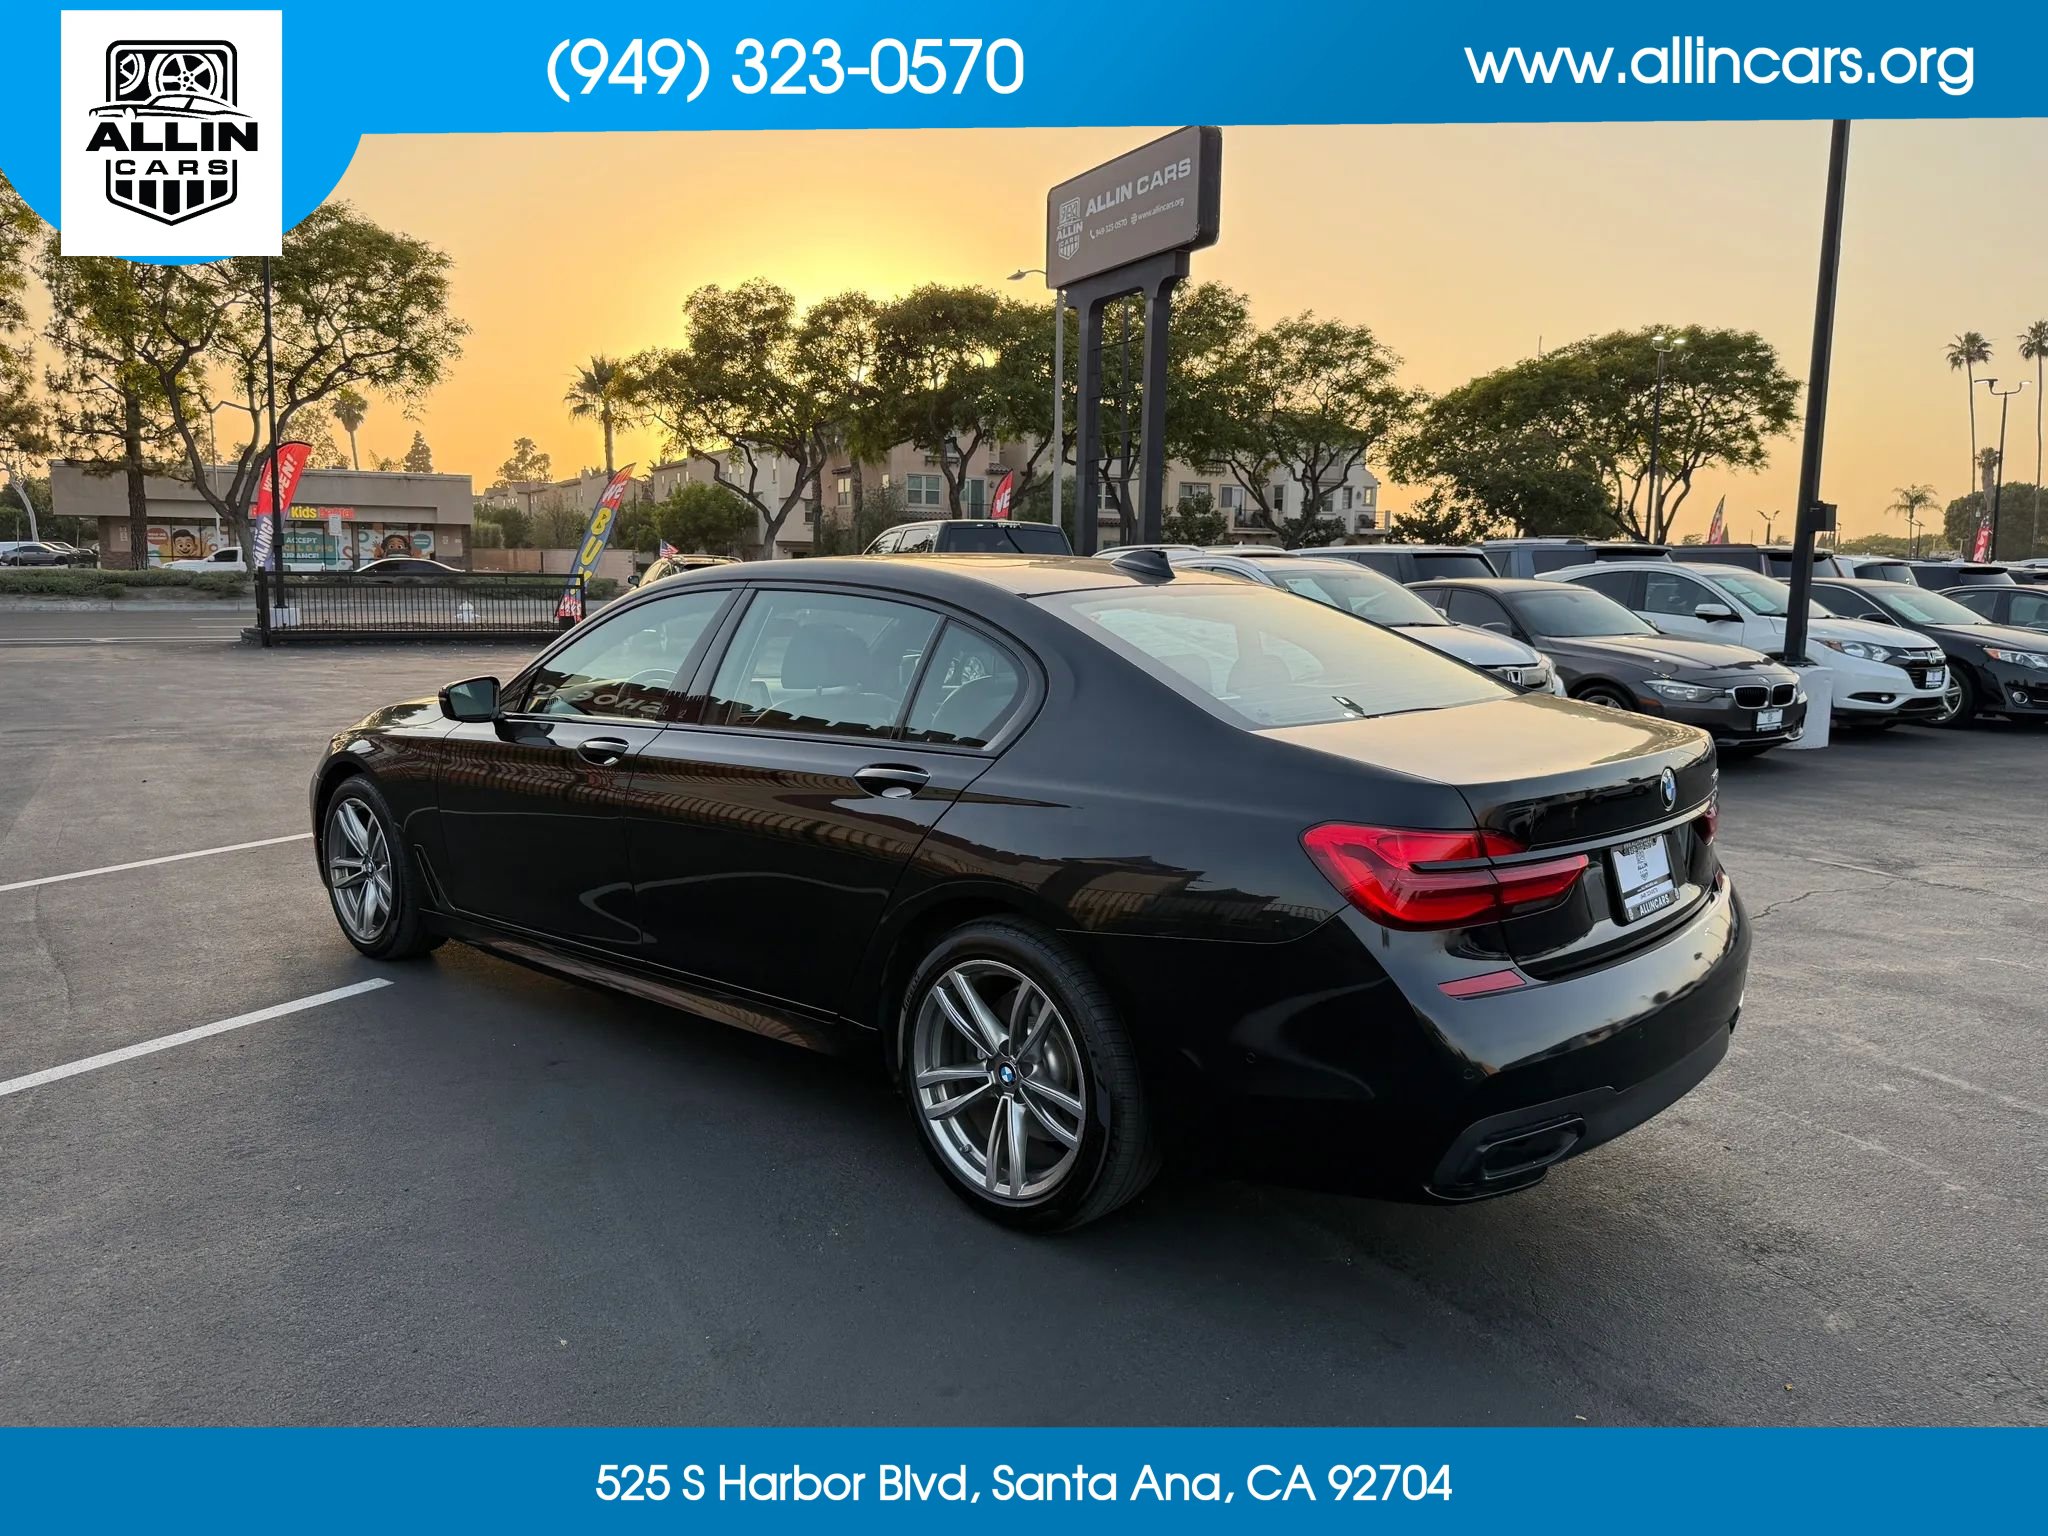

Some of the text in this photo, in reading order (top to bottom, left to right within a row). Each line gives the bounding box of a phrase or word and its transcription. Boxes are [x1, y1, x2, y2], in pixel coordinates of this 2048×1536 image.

[1085, 157, 1191, 217] ALLIN CARS
[1056, 221, 1083, 242] ALLIN
[291, 507, 317, 519] Kids
[286, 536, 318, 546] ACCEPT
